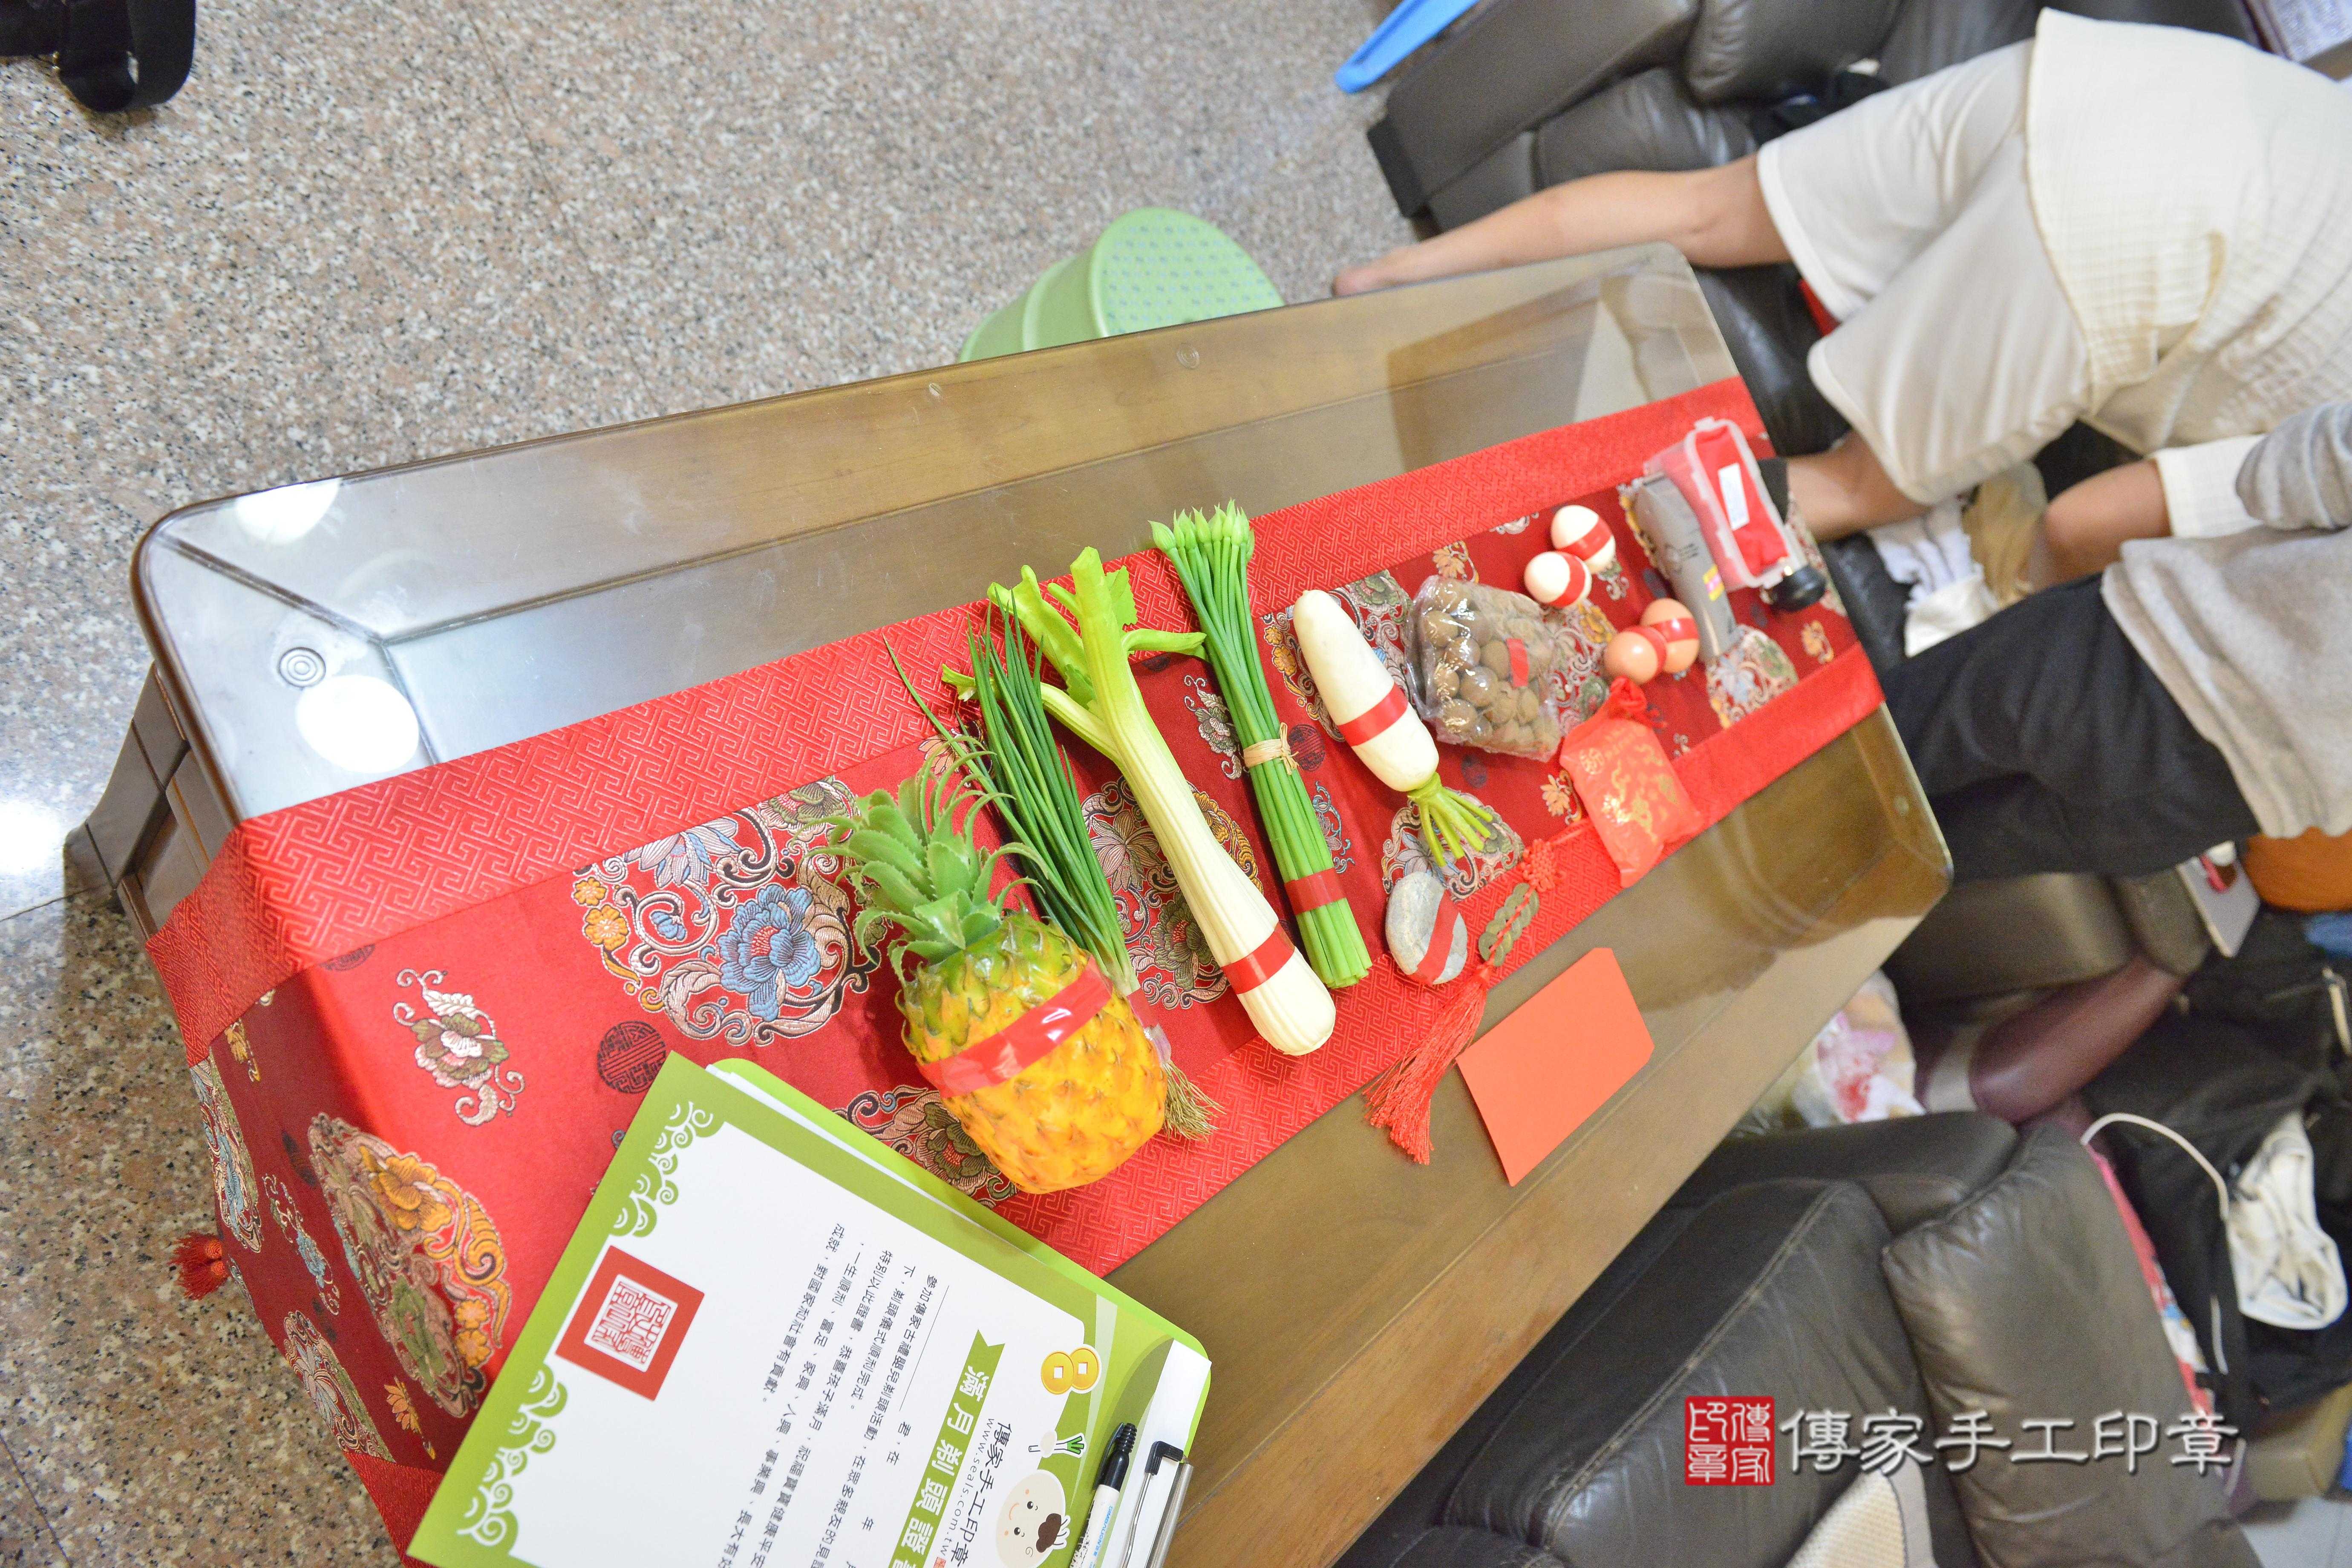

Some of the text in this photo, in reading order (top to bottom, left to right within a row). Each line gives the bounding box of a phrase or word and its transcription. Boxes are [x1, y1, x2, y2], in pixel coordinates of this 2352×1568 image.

[861, 1516, 874, 1531] 年
[892, 1366, 989, 1568] 滿月剃頭證
[941, 1419, 994, 1556] www.seals.com.tw
[951, 1423, 1012, 1568] 傳家手工印章
